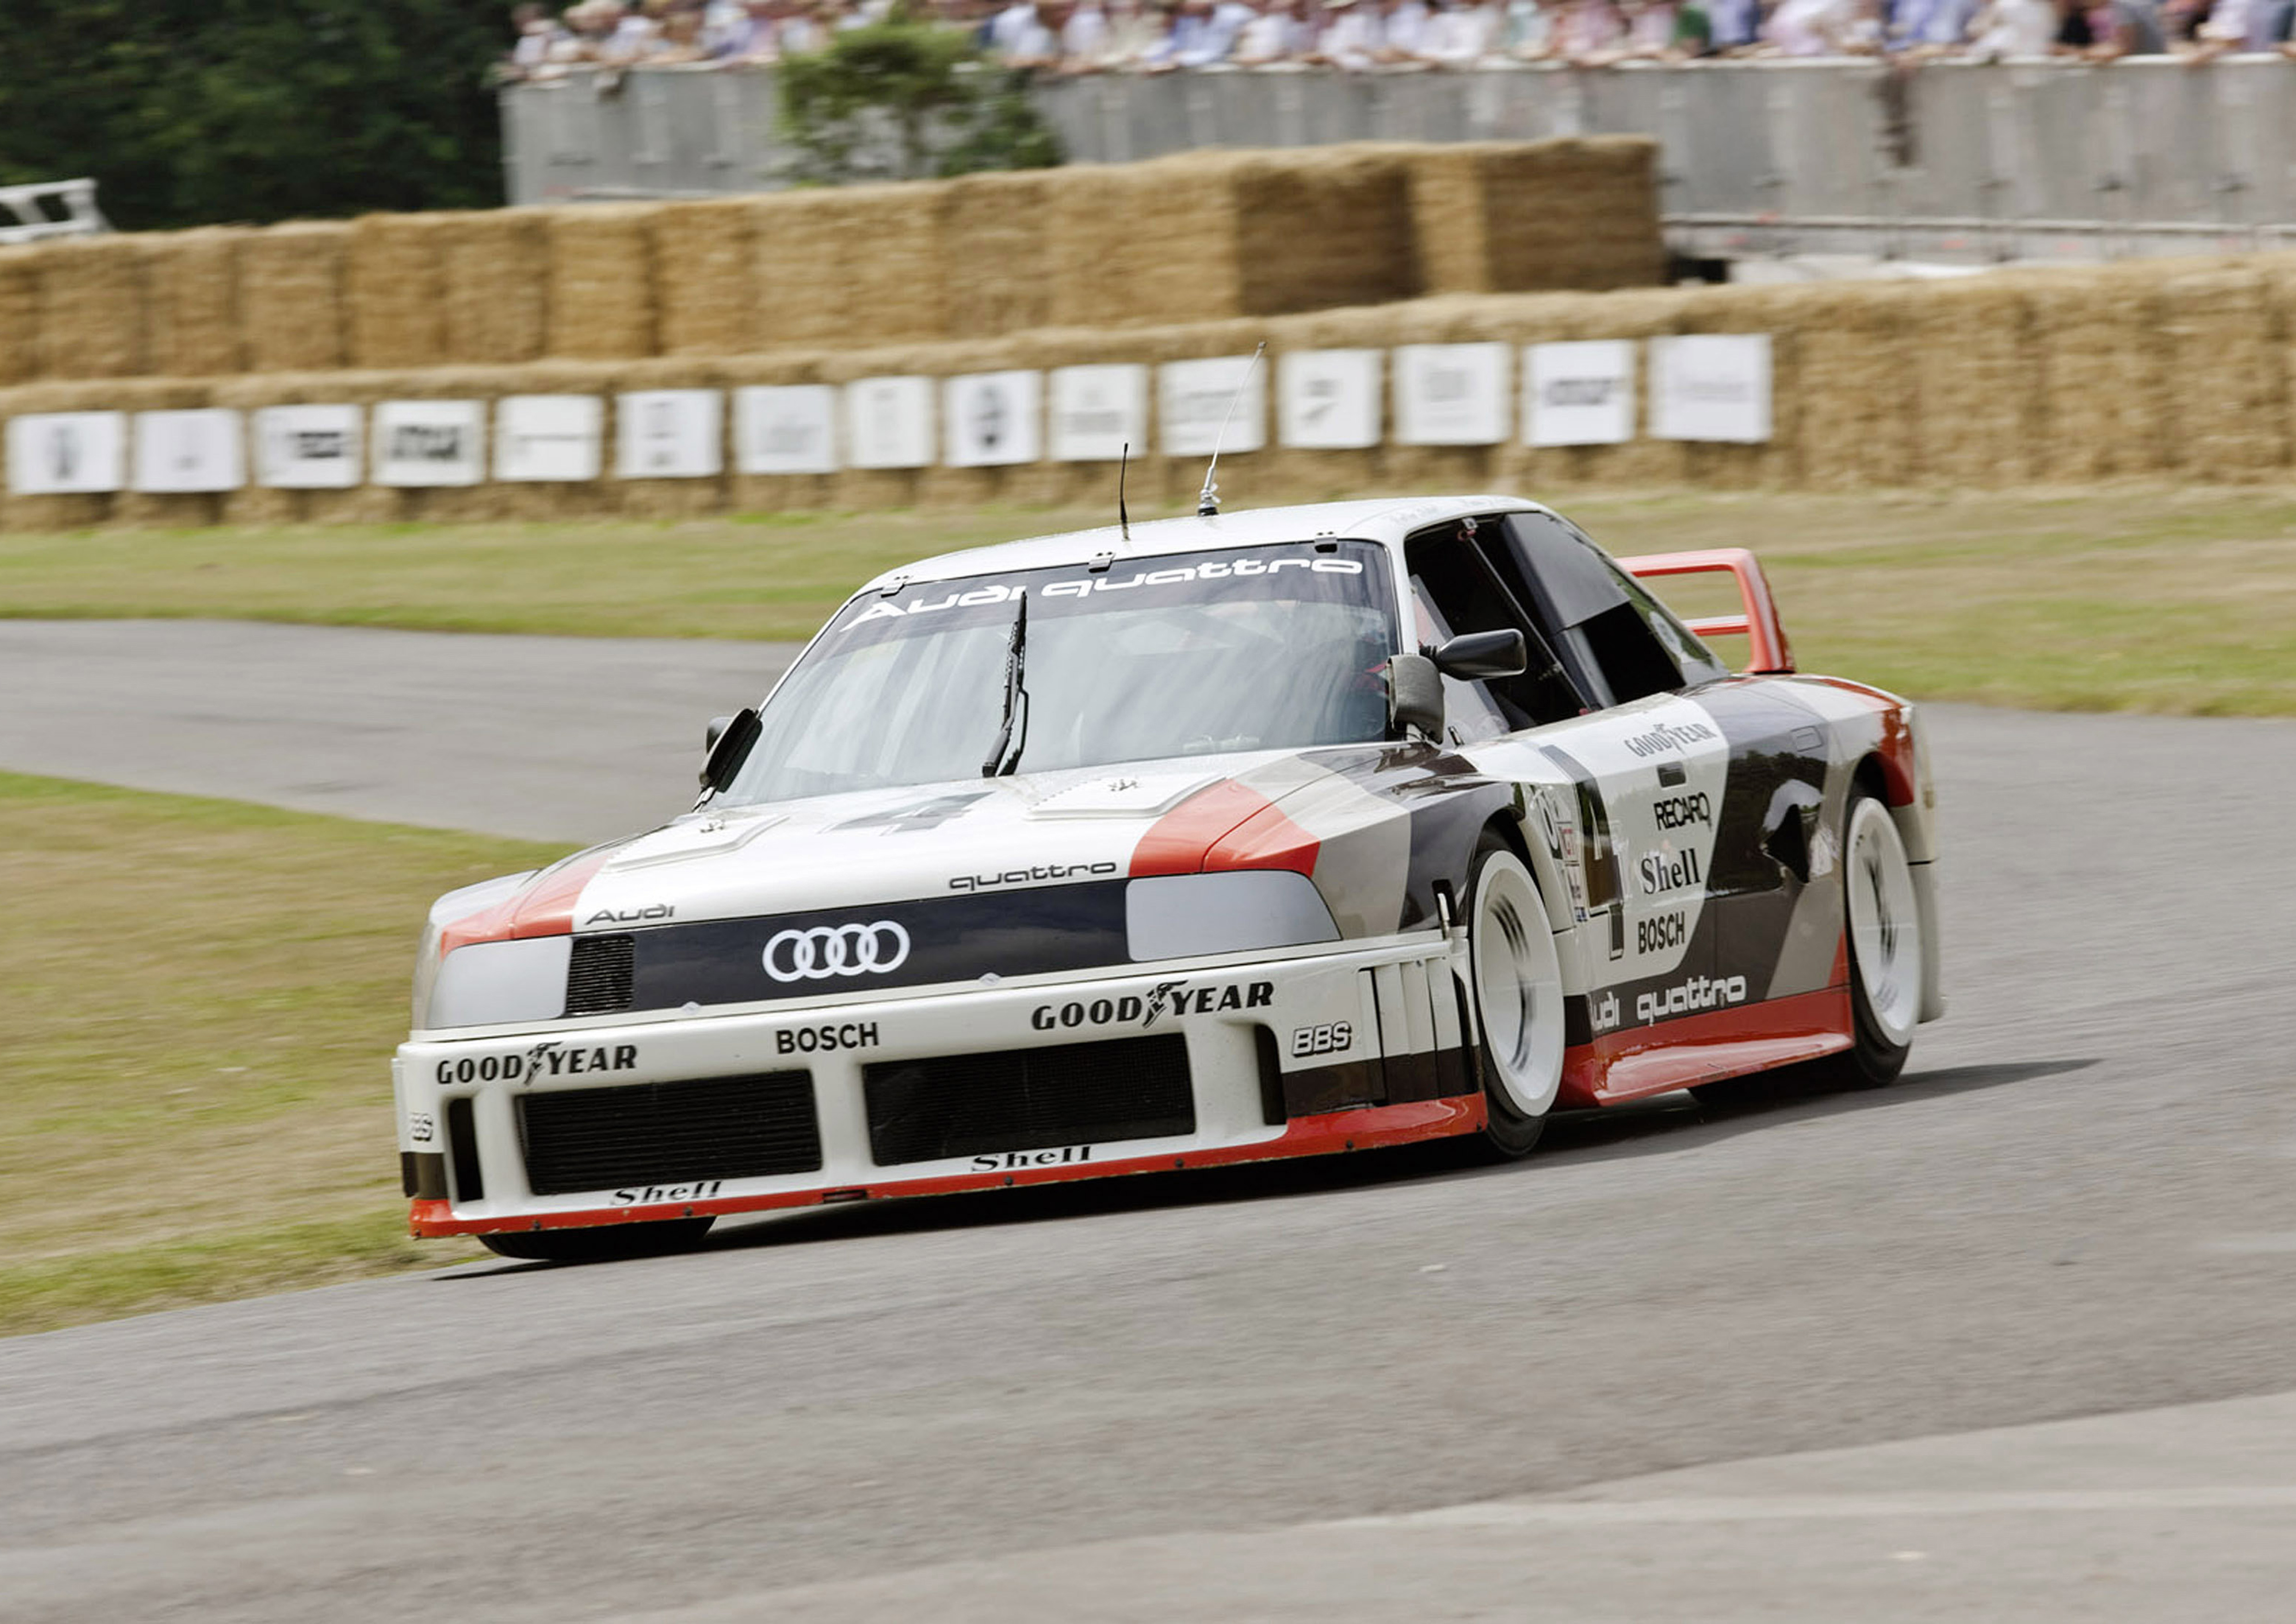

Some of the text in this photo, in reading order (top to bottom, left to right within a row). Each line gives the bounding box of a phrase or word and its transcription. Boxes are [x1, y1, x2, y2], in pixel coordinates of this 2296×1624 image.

[840, 558, 1363, 632] Audi quattro
[1653, 792, 1712, 831] RECARO
[949, 862, 1117, 891] quattro
[1641, 848, 1701, 894] Shell
[585, 903, 675, 924] Audi
[1637, 912, 1686, 955] BOSCH
[1637, 975, 1747, 1027] quattro
[776, 1022, 879, 1054] BOSCH
[1292, 1021, 1352, 1057] BBS
[971, 1145, 1090, 1172] Shell
[610, 1181, 722, 1206] Shell
